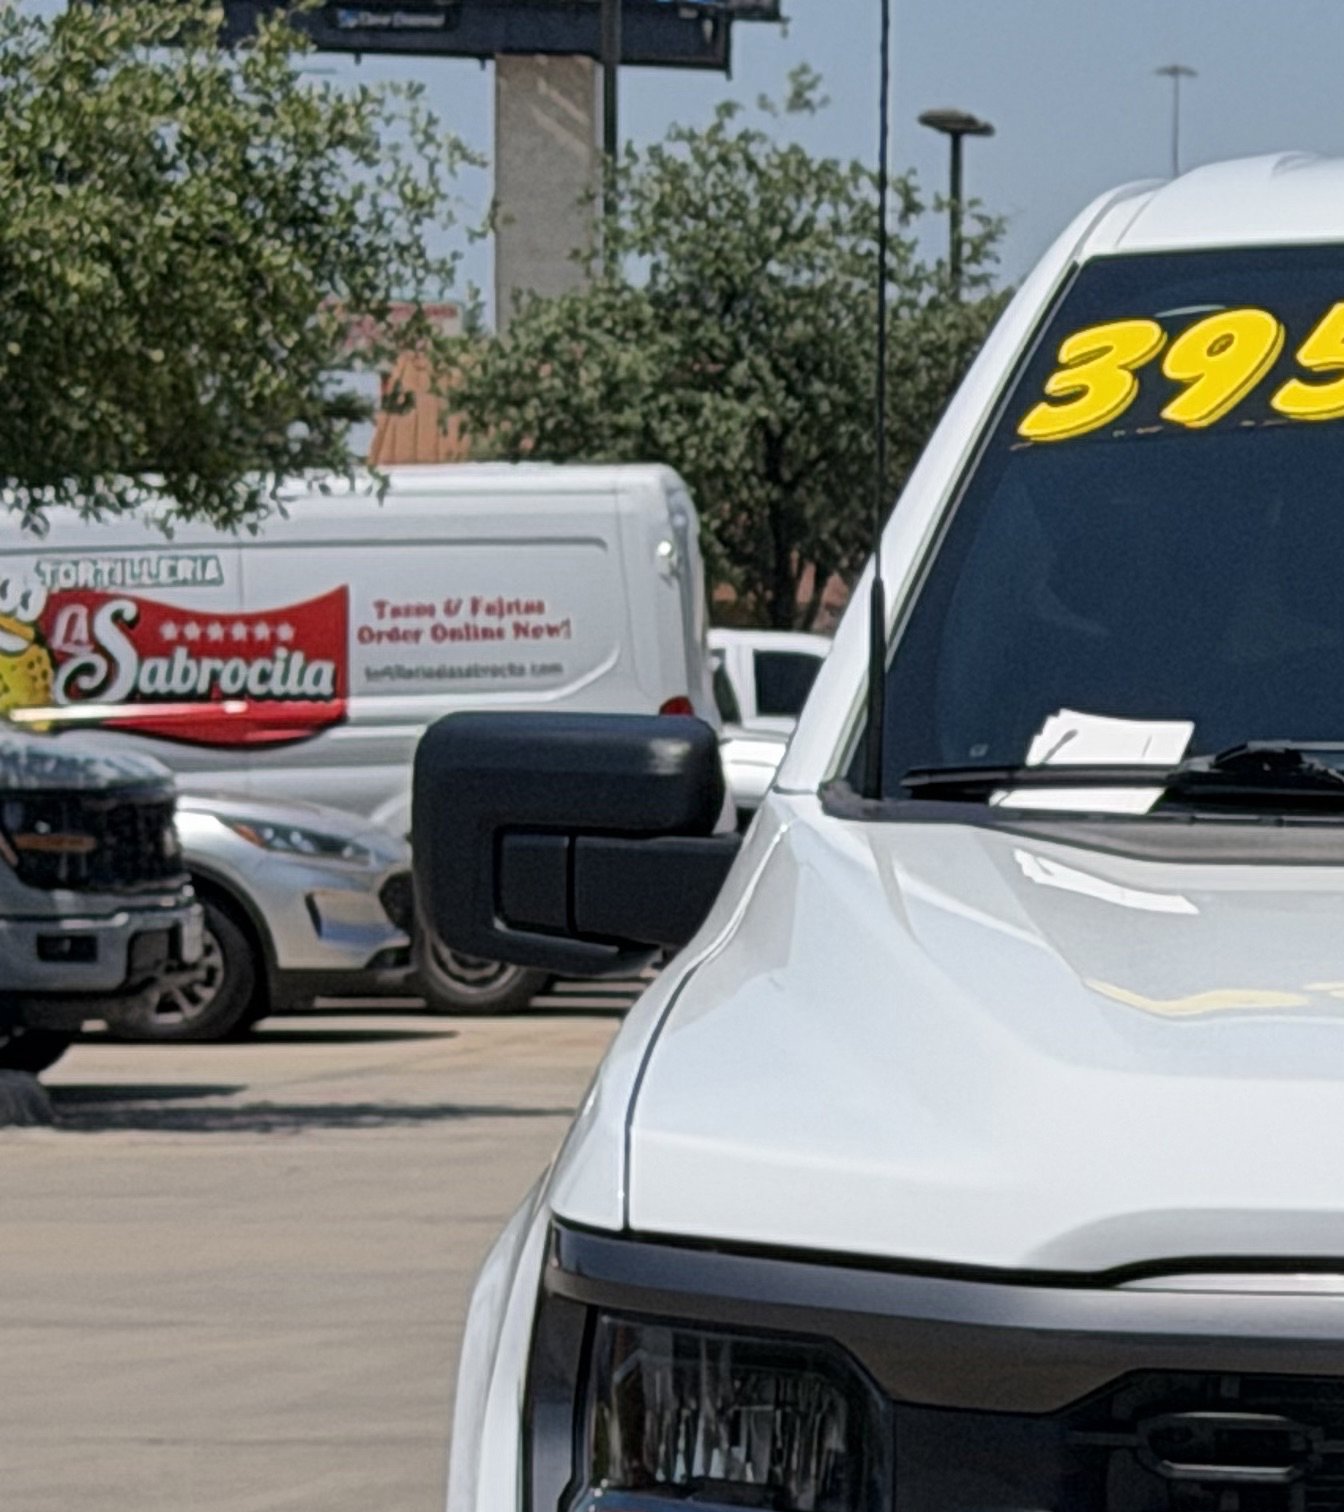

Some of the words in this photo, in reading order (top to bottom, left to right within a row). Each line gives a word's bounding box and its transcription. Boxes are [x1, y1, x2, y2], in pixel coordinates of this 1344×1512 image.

[35, 555, 224, 587] TORTILLERIA
[373, 598, 436, 620] Tacos
[469, 596, 545, 620] Fajitas
[357, 624, 423, 646] Order
[430, 620, 505, 643] Online
[512, 617, 571, 640] Now!
[53, 599, 336, 705] Sabrocita
